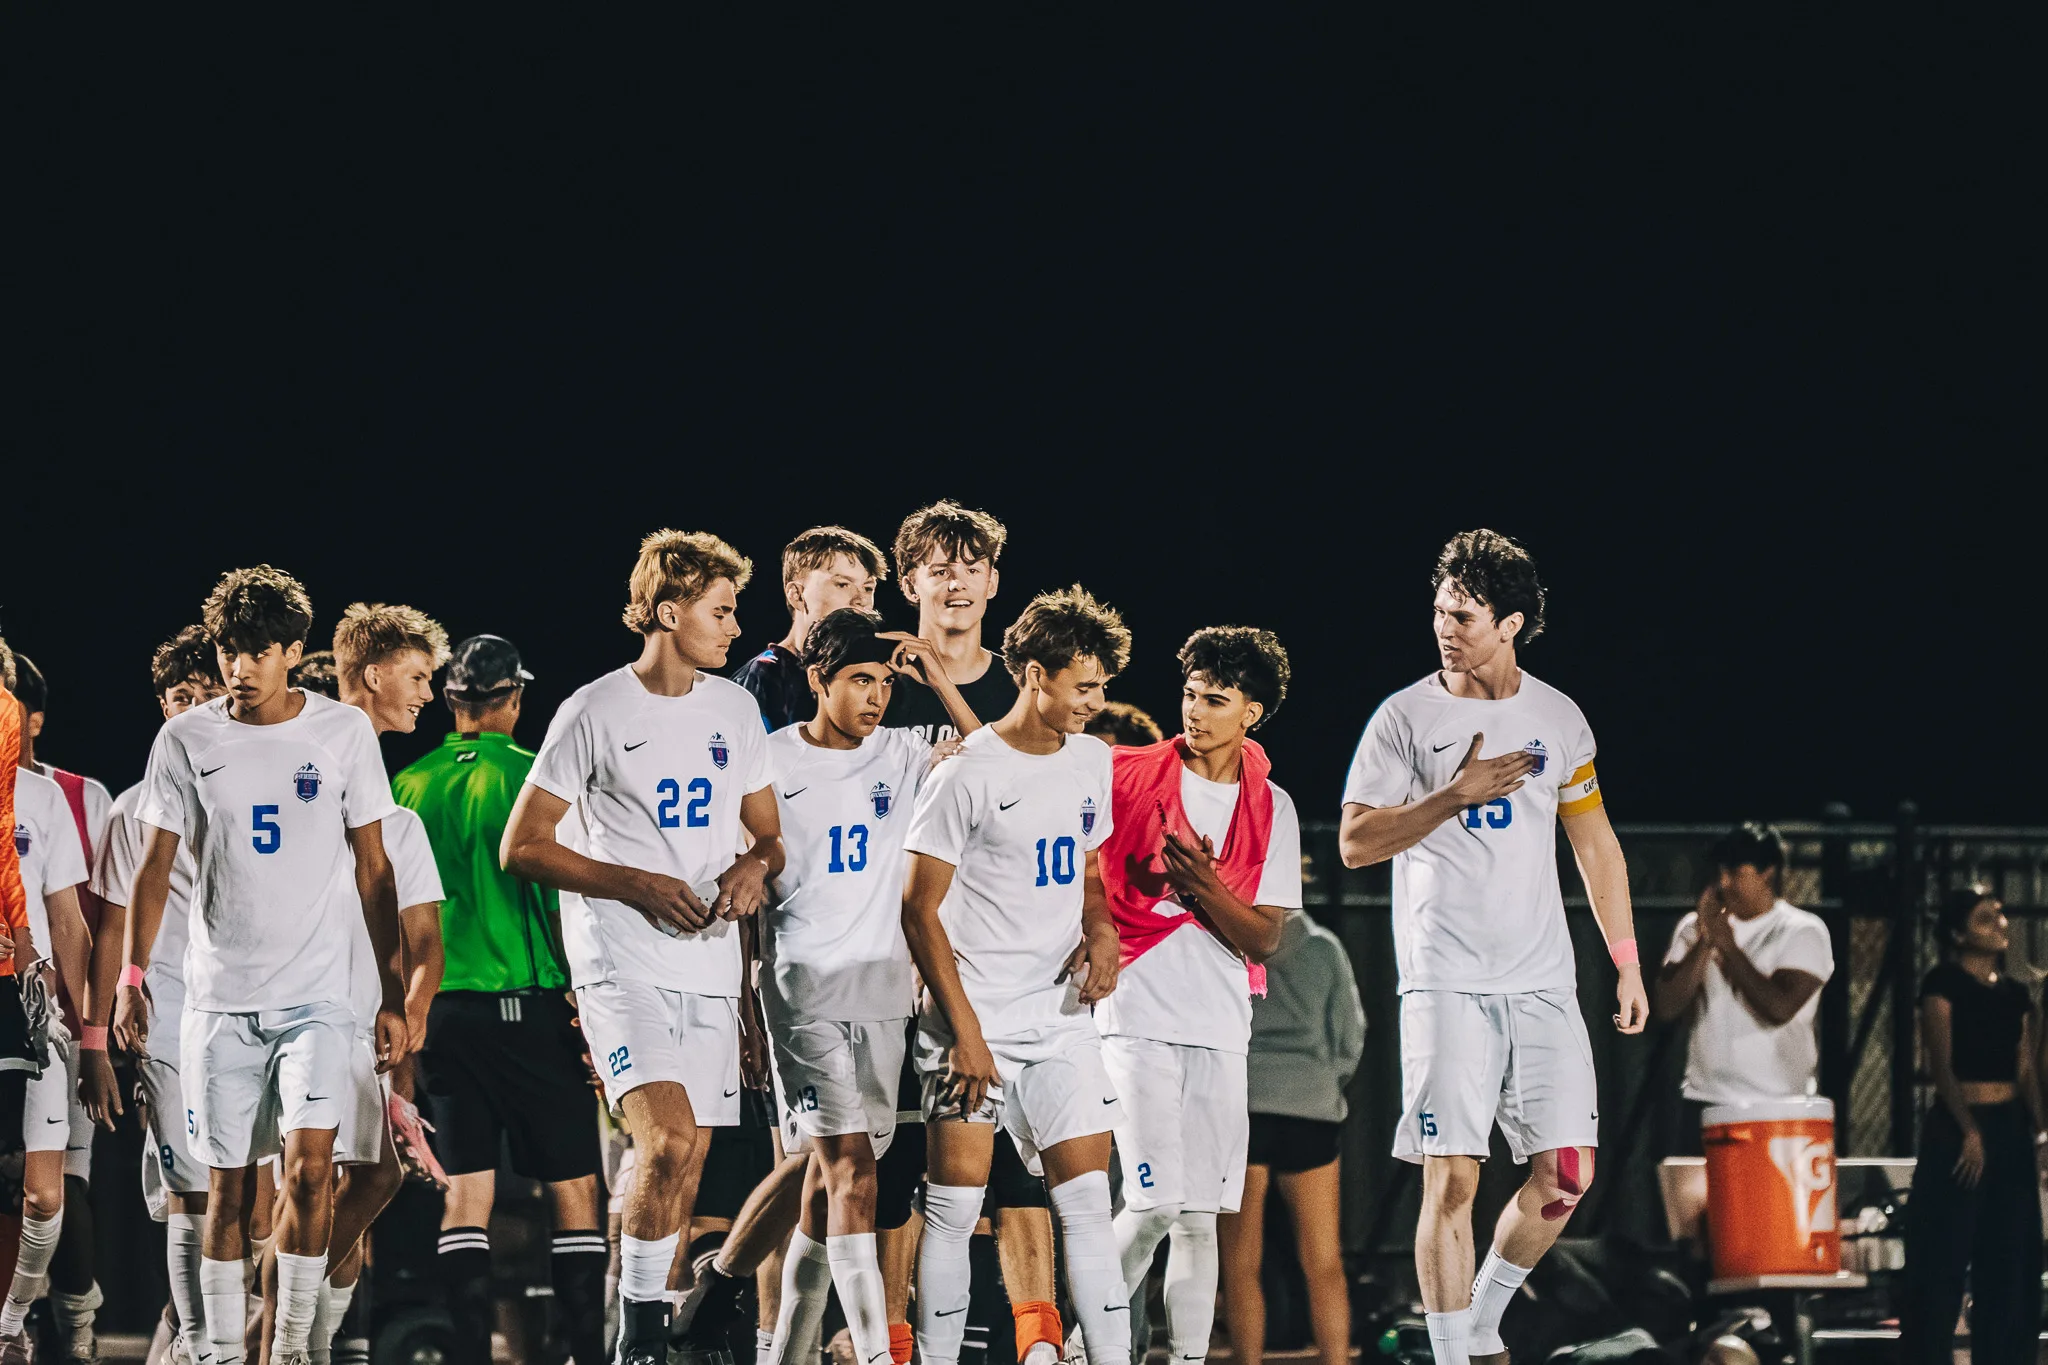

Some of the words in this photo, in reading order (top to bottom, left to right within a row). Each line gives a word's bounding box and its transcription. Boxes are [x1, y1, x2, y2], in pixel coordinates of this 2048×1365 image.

[656, 777, 712, 828] 22
[252, 804, 281, 854] 5
[828, 824, 869, 873] 13
[1035, 836, 1076, 887] 10
[608, 1045, 632, 1077] 22
[797, 1085, 819, 1113] 13
[187, 1108, 194, 1135] 5
[1418, 1112, 1438, 1137] 15
[1137, 1162, 1155, 1188] 2
